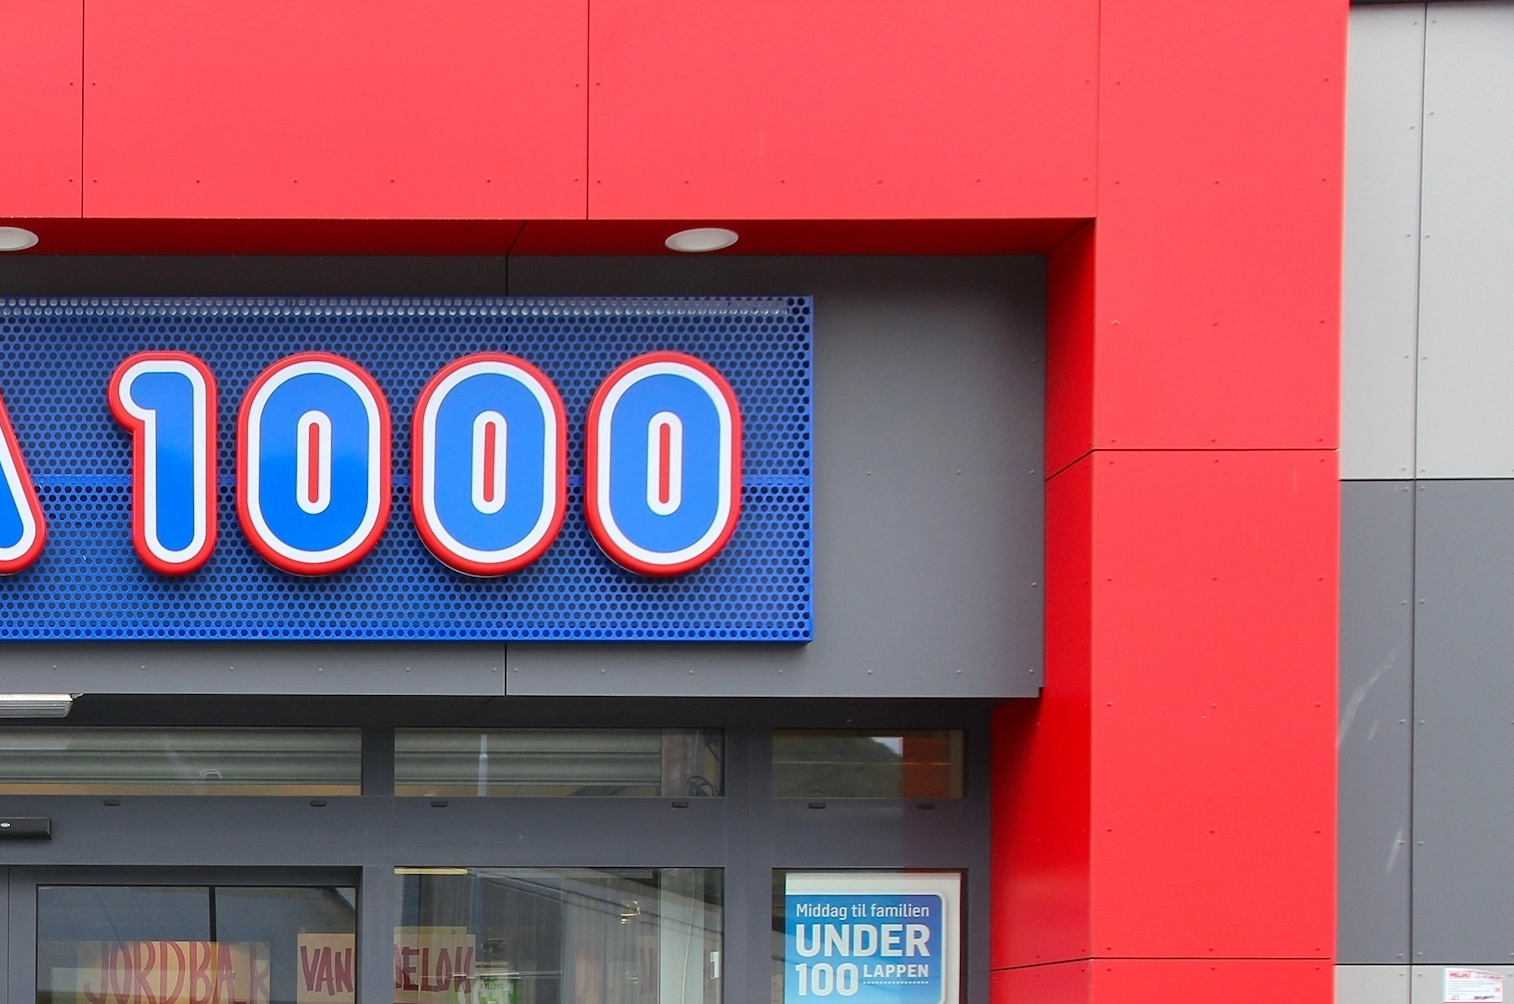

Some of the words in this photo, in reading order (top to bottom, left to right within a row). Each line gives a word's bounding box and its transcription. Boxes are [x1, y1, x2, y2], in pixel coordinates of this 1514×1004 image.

[107, 350, 743, 578] 1000
[796, 903, 847, 921] Middag
[851, 903, 867, 918] til
[870, 903, 930, 918] familien
[795, 923, 931, 958] UNDER
[795, 962, 859, 997] 100
[863, 964, 929, 978] LAPPEN
